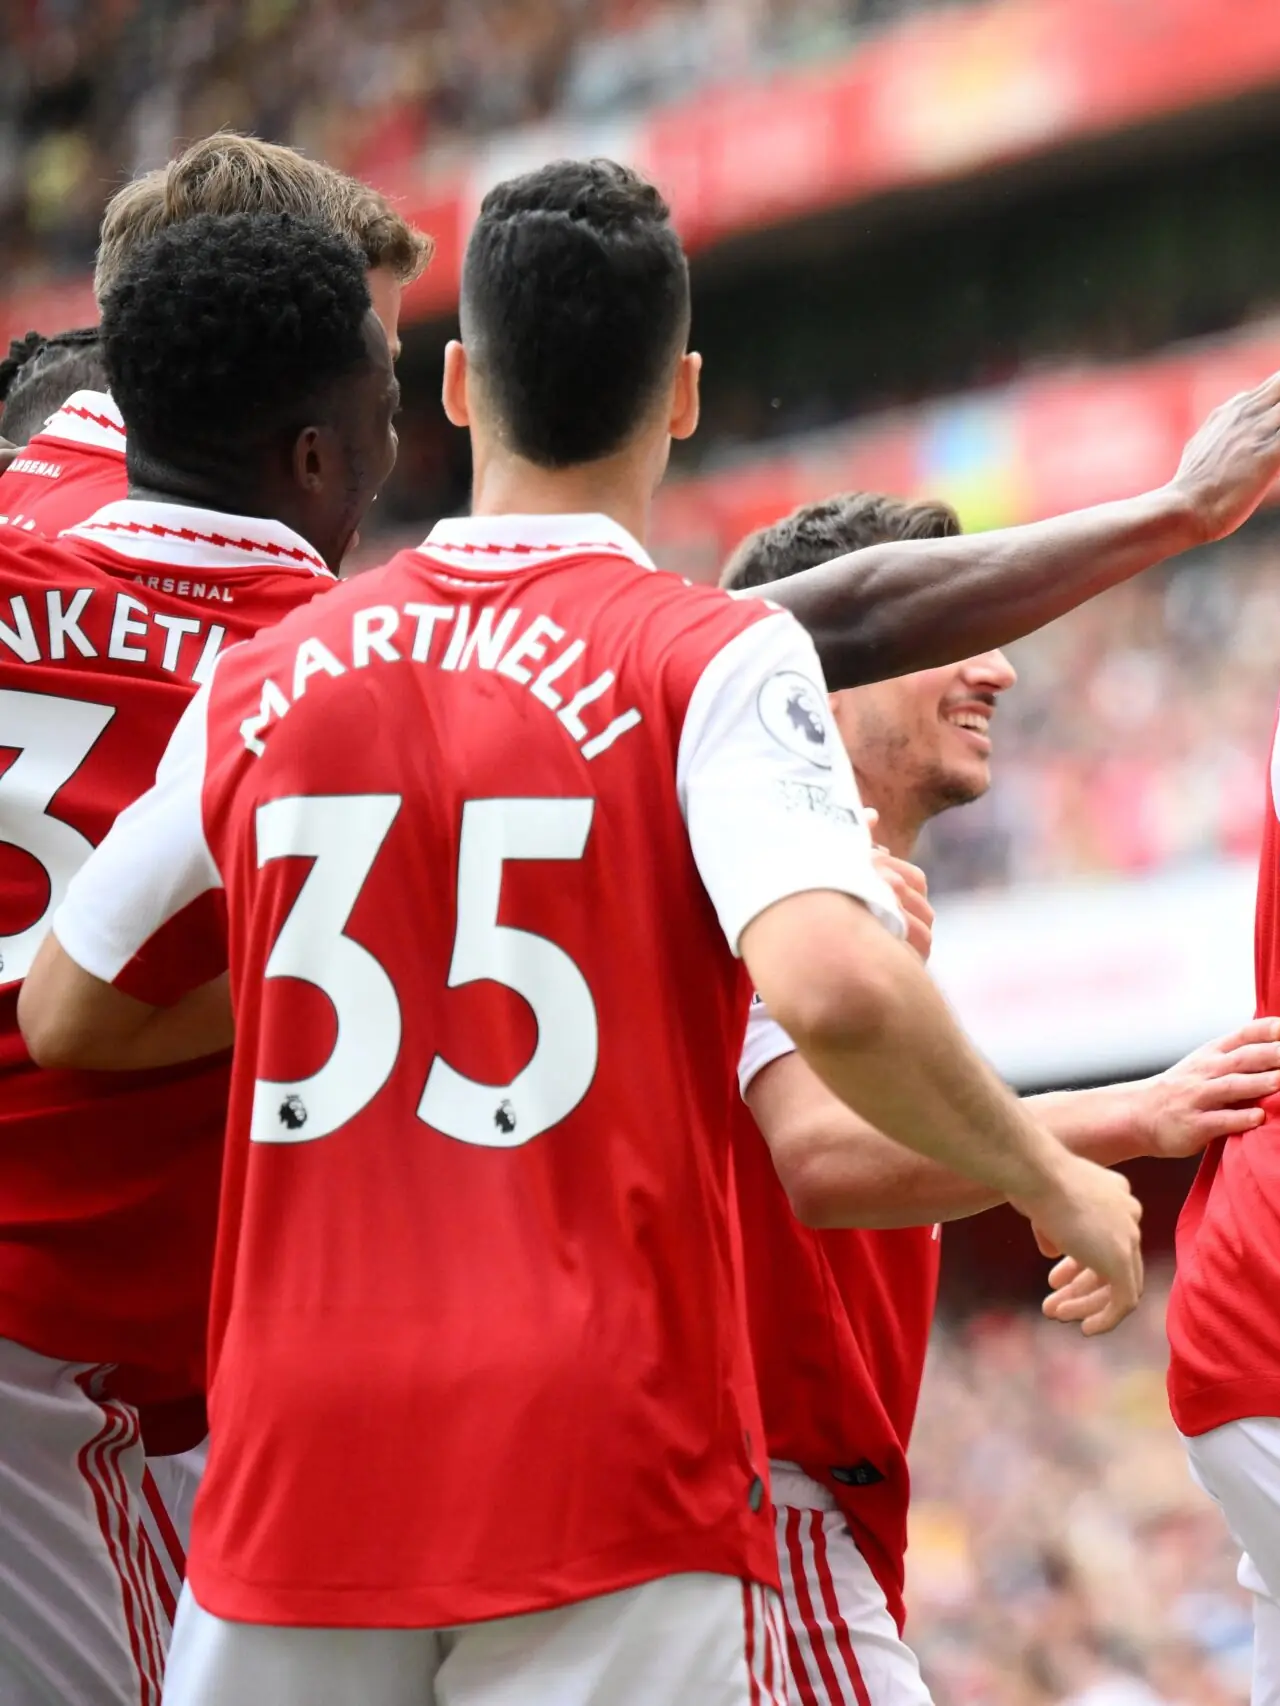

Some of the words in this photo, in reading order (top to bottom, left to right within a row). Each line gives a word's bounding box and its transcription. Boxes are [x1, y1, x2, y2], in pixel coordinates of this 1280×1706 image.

[7, 458, 62, 480] ARSENAL
[134, 574, 235, 603] ARSENAL
[239, 601, 643, 762] MARTINELLI
[250, 794, 599, 1148] 35
